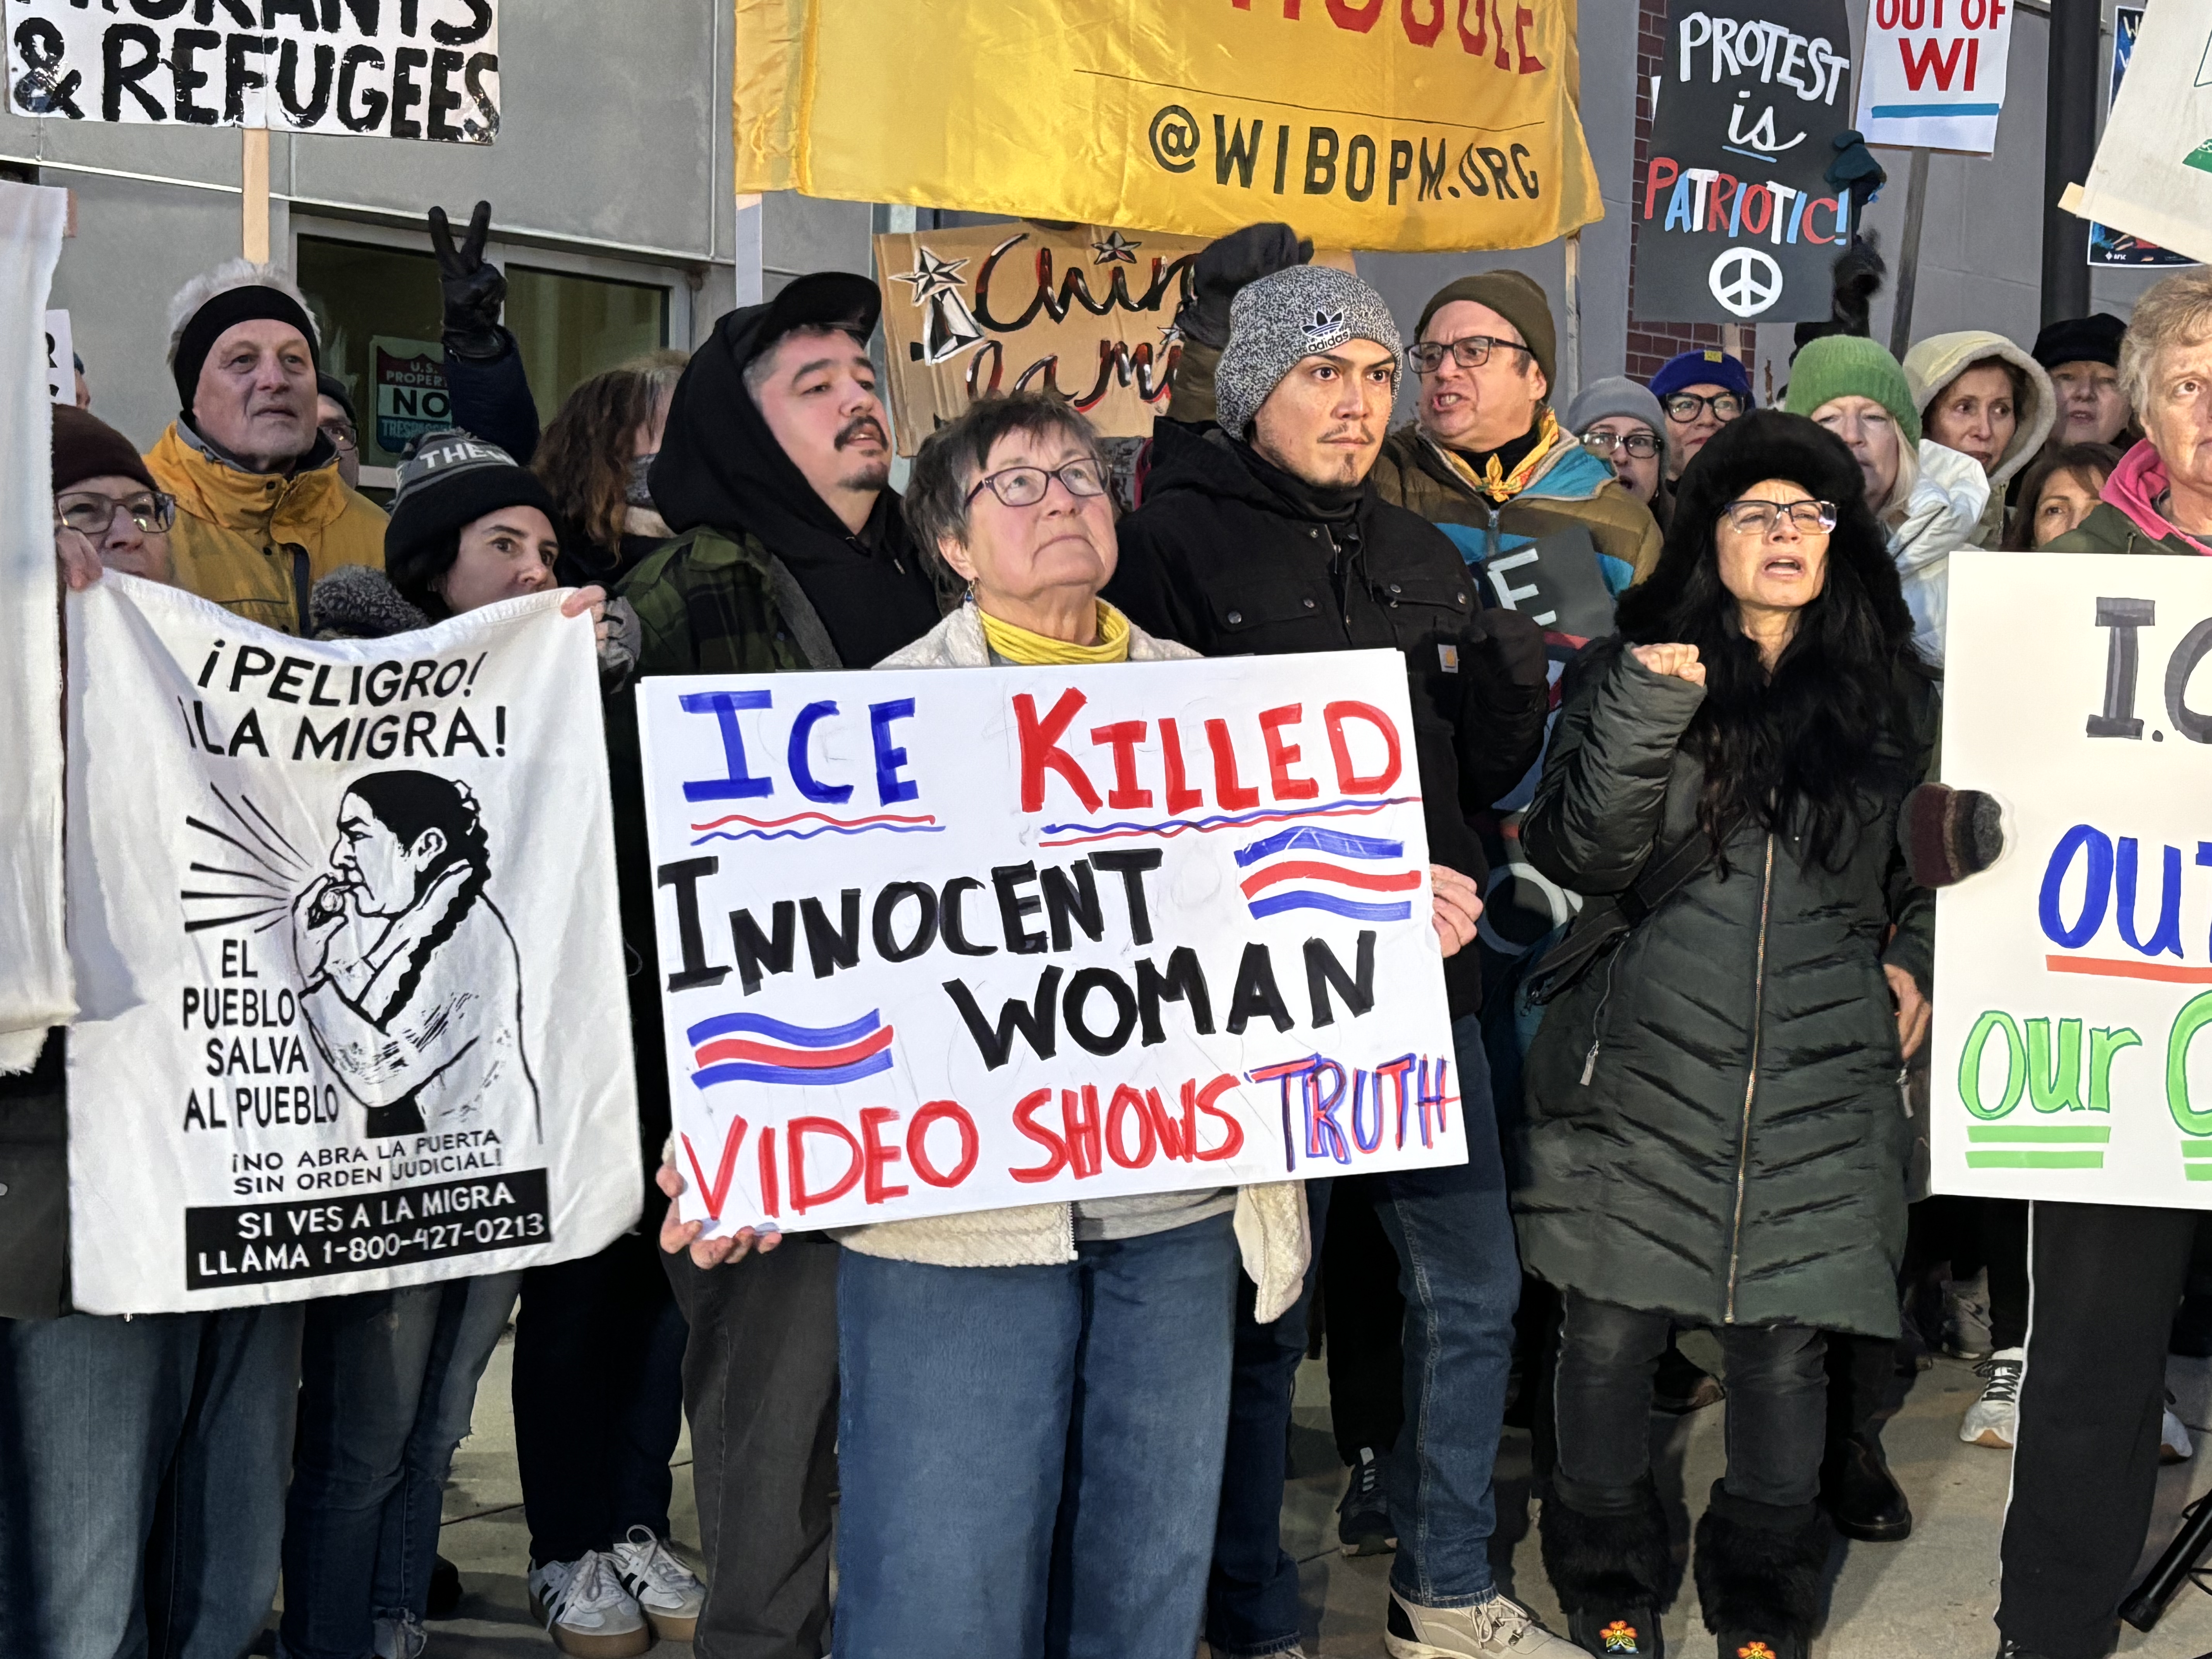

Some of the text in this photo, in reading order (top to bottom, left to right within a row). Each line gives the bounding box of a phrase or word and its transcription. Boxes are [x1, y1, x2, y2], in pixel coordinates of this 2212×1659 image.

[14, 17, 85, 119] &
[102, 24, 500, 144] REFUGEES
[1680, 12, 1850, 105] PROTEST
[1898, 38, 1979, 91] WI
[1728, 91, 1807, 151] is
[1149, 105, 1539, 205] @WIBOPM.ORG
[1645, 157, 1849, 245] PATRIOTIC!
[410, 361, 438, 374] U.S.
[1309, 331, 1349, 352] adidas
[386, 370, 448, 387] PROPER
[393, 388, 450, 417] NO
[198, 639, 488, 706] ¡PELIGRO!
[292, 706, 506, 761] MIGRA!
[678, 687, 1402, 816] ICE KILLED
[657, 848, 1163, 996] INNOCENT
[222, 939, 258, 978] EL
[183, 987, 295, 1030] PUEBLO
[942, 930, 1377, 1071] WOMAN
[206, 1034, 309, 1077] SALVA
[184, 1084, 338, 1132] AL PUEBLO
[297, 1146, 369, 1168] ABRA
[378, 1140, 405, 1160] LA
[416, 1129, 501, 1155] PUERTA
[680, 1052, 1461, 1221] VIDEO SHOWS TRUTH
[233, 1149, 502, 1195] SIN ORDEN JUDICIAL!
[238, 1182, 516, 1240] SI VES A LA MIGRA
[199, 1212, 545, 1276] LLAMA 1-800-427-0213
